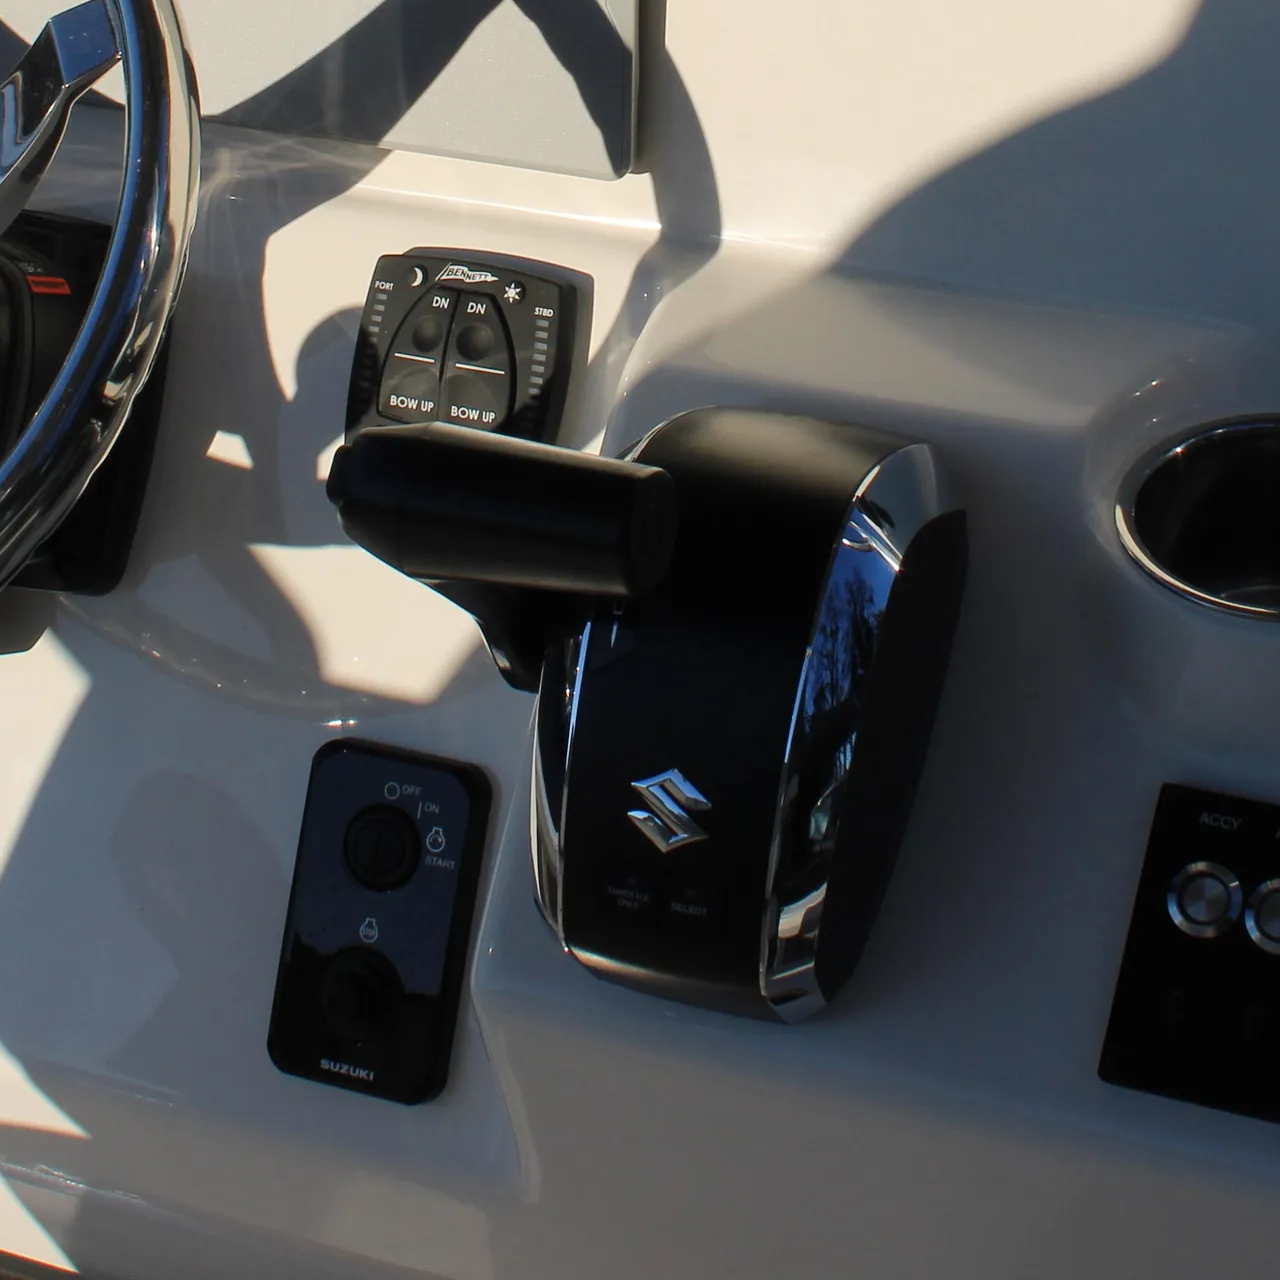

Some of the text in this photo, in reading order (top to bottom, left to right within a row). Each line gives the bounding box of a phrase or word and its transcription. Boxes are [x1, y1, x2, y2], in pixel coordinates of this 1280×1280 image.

[447, 267, 491, 282] BENNETT
[375, 280, 395, 291] PORT
[433, 296, 450, 309] DN
[467, 302, 486, 315] DN
[534, 307, 554, 318] STBD
[389, 394, 434, 413] BOW UP
[451, 405, 496, 424] BOW UP
[402, 784, 422, 797] OFF
[424, 802, 440, 815] ON
[1198, 811, 1244, 831] ACCY
[425, 856, 456, 870] START
[320, 1058, 375, 1082] SUZUKI
